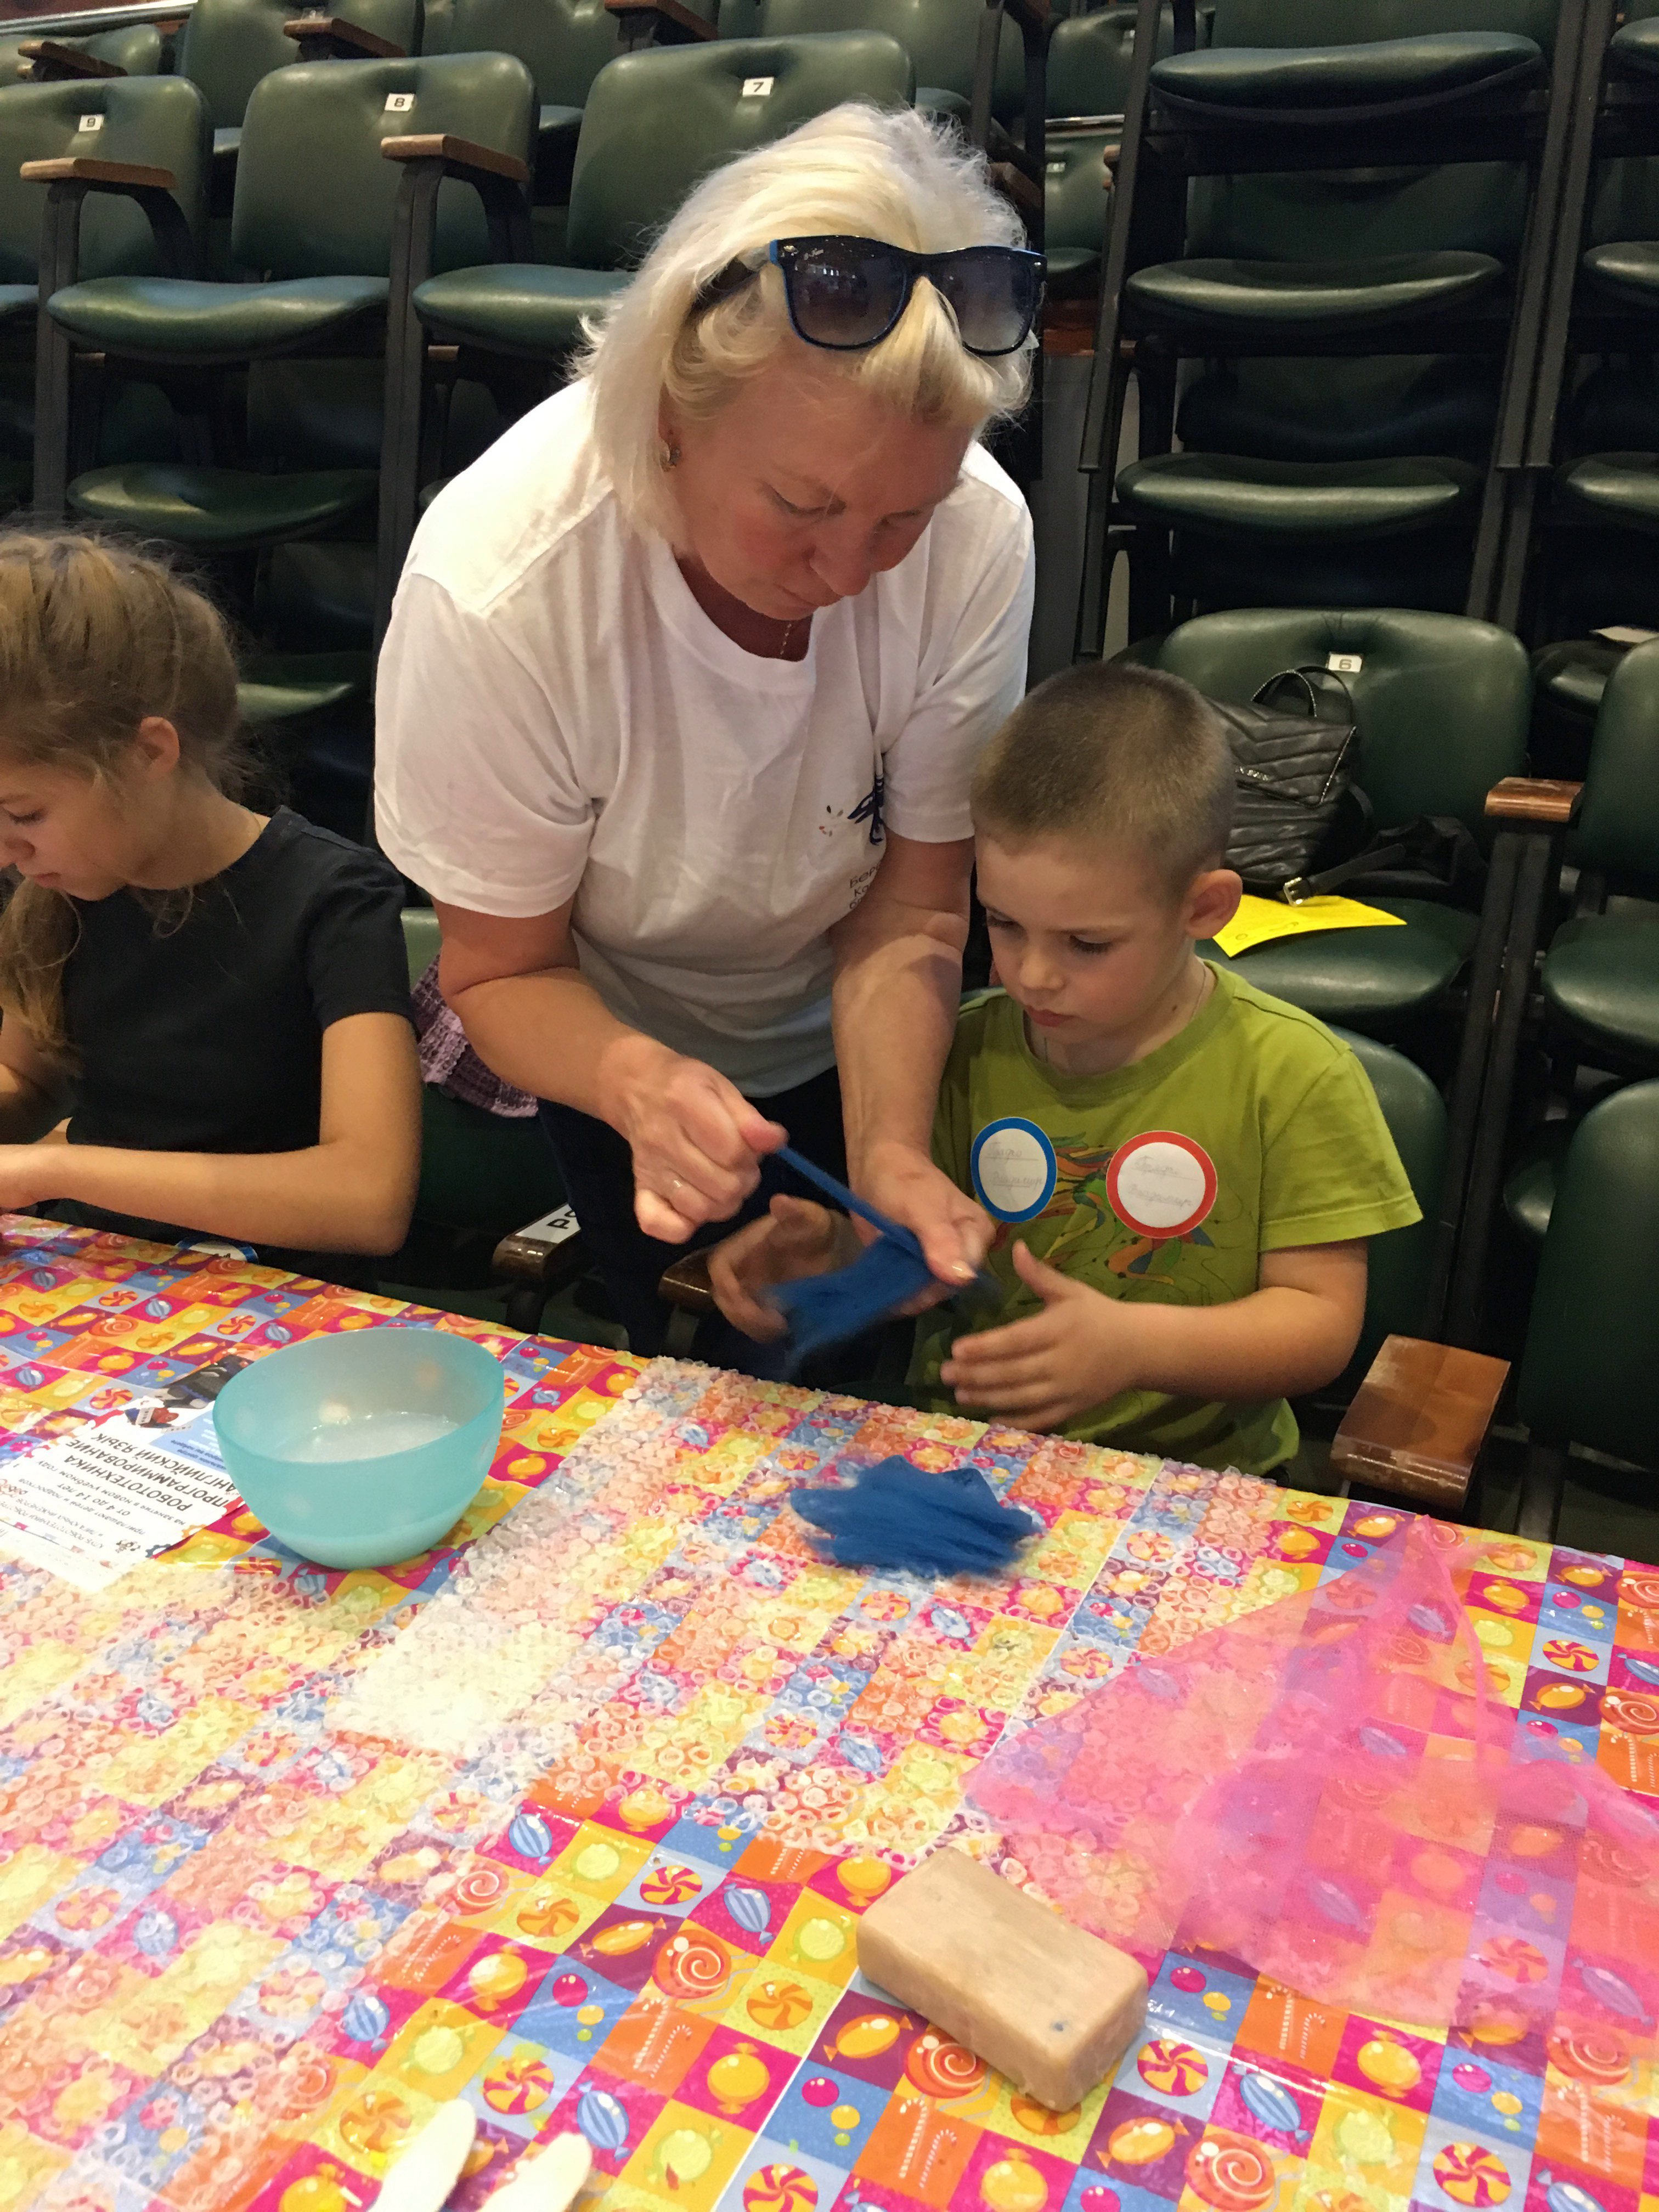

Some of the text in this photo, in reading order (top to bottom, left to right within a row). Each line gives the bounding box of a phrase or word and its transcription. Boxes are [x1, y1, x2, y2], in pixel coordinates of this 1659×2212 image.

[753, 82, 765, 93] 7
[394, 97, 405, 107] 8
[87, 116, 96, 128] 9
[1339, 658, 1352, 670] 6
[35, 1459, 59, 1472] году
[91, 1431, 237, 1493] АНГЛИЙСКИЙ ЯЗЫК
[65, 1437, 230, 1509] ПРОГРАММИРОВАНИЕ
[58, 1470, 101, 1492] учебном
[63, 1454, 193, 1513] РОБОТОТЕХНИКА
[18, 1477, 63, 1499] подростков
[56, 1482, 77, 1494] лет
[75, 1491, 92, 1500] 14
[100, 1488, 133, 1504] новом
[68, 1499, 96, 1513] детей
[92, 1497, 110, 1508] до
[116, 1509, 131, 1517] от
[140, 1505, 174, 1521] занятия
[57, 1514, 80, 1527] ЮНЫХ
[93, 1511, 146, 1536] приглашают
[79, 1525, 98, 1535] ЛИГА
